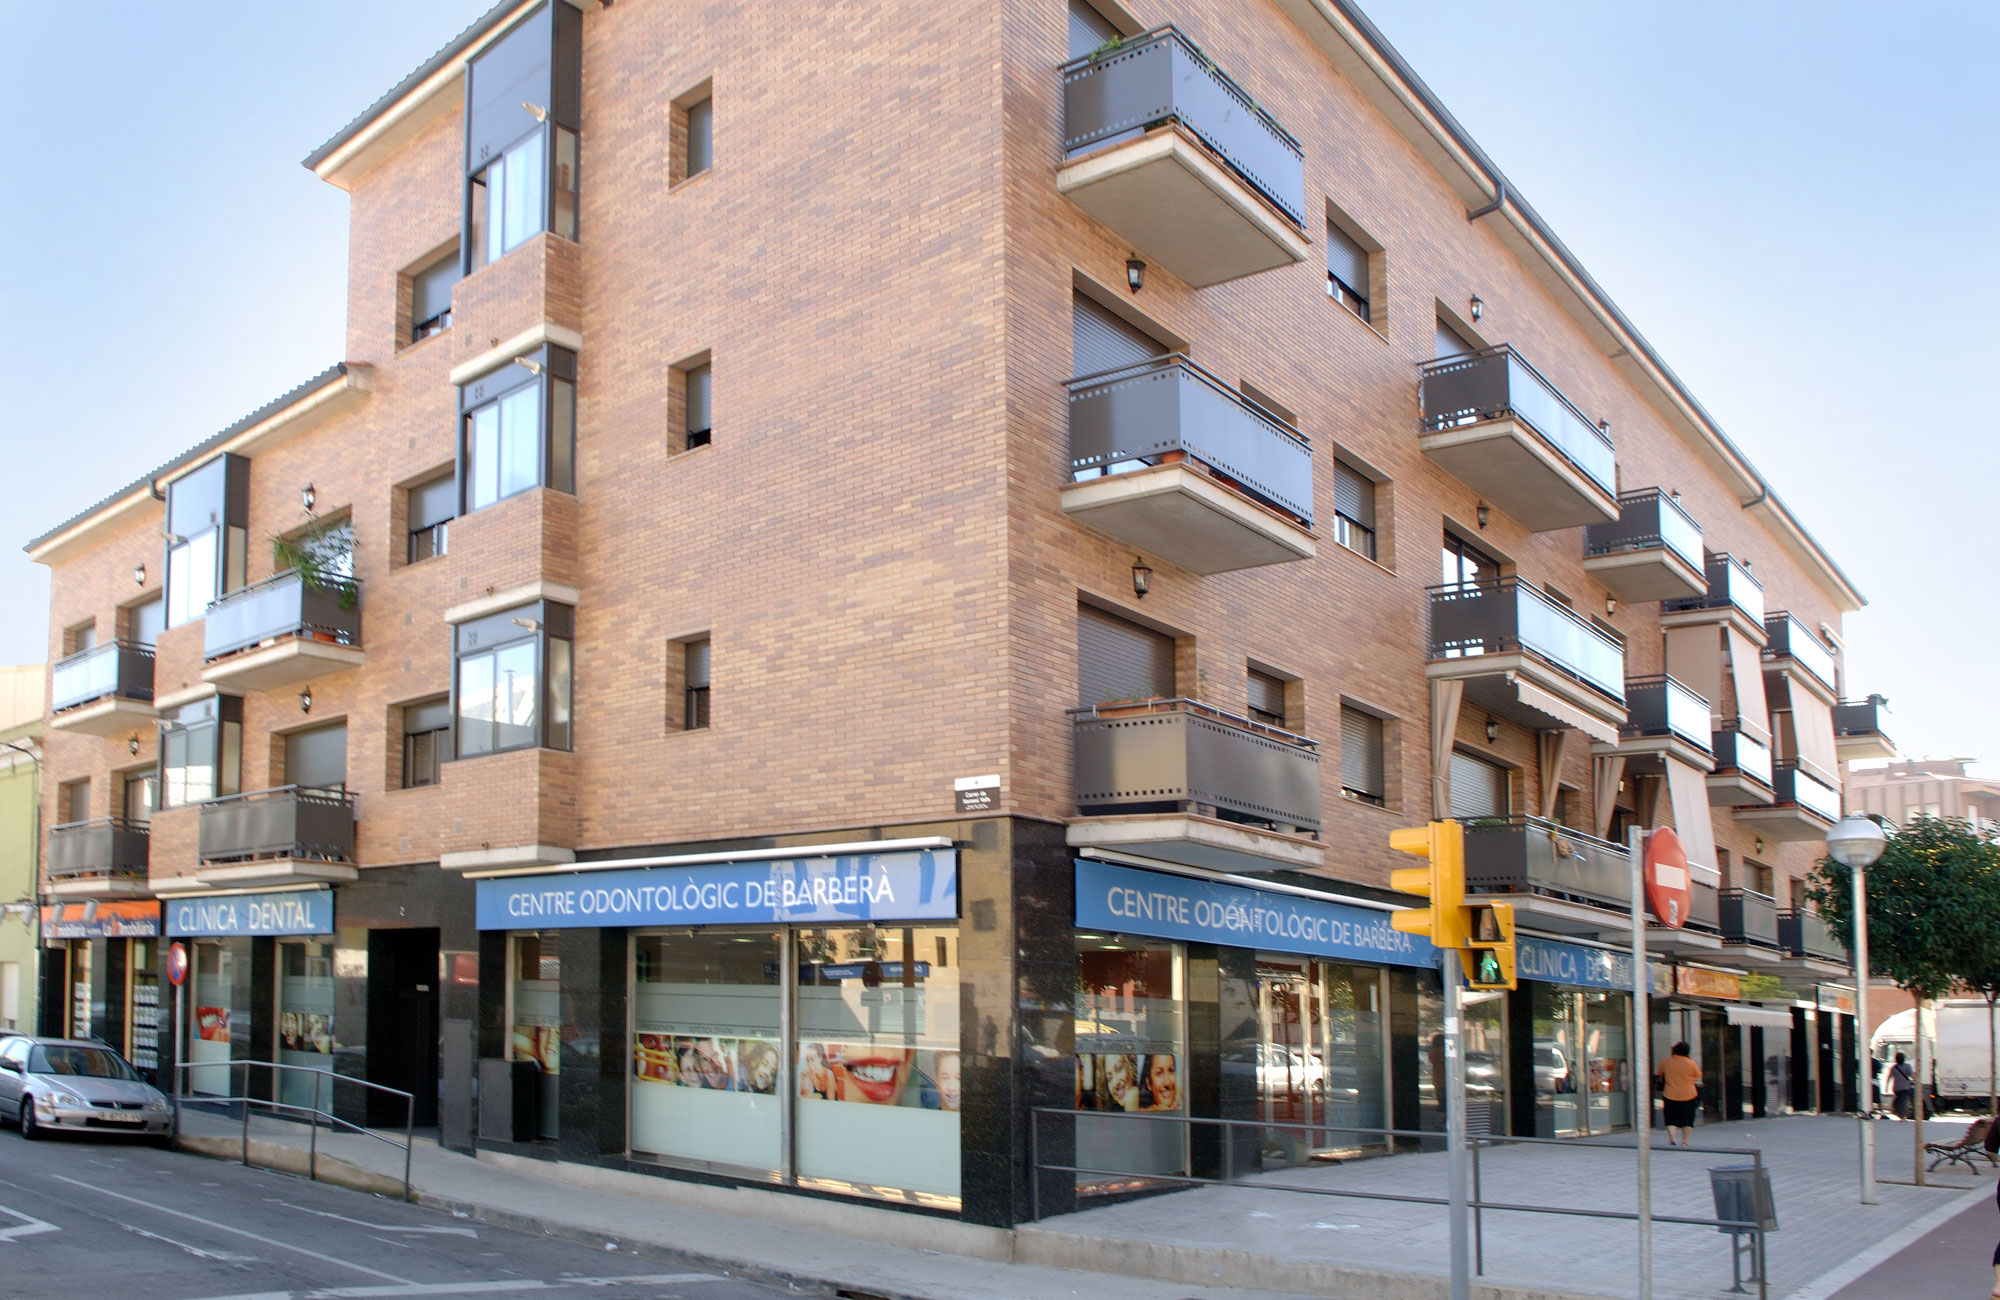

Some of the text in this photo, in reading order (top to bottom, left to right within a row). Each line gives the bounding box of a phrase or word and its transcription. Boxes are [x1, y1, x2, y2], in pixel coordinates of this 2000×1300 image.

[178, 900, 316, 932] CLÍNICA DENTAL
[508, 864, 896, 917] CENTRE ODONTOLÒGIC DE BARBERÀ
[1107, 886, 1191, 925] CENTRE
[1194, 899, 1329, 943] ODONTOLÒGIC
[1331, 920, 1352, 946] DE
